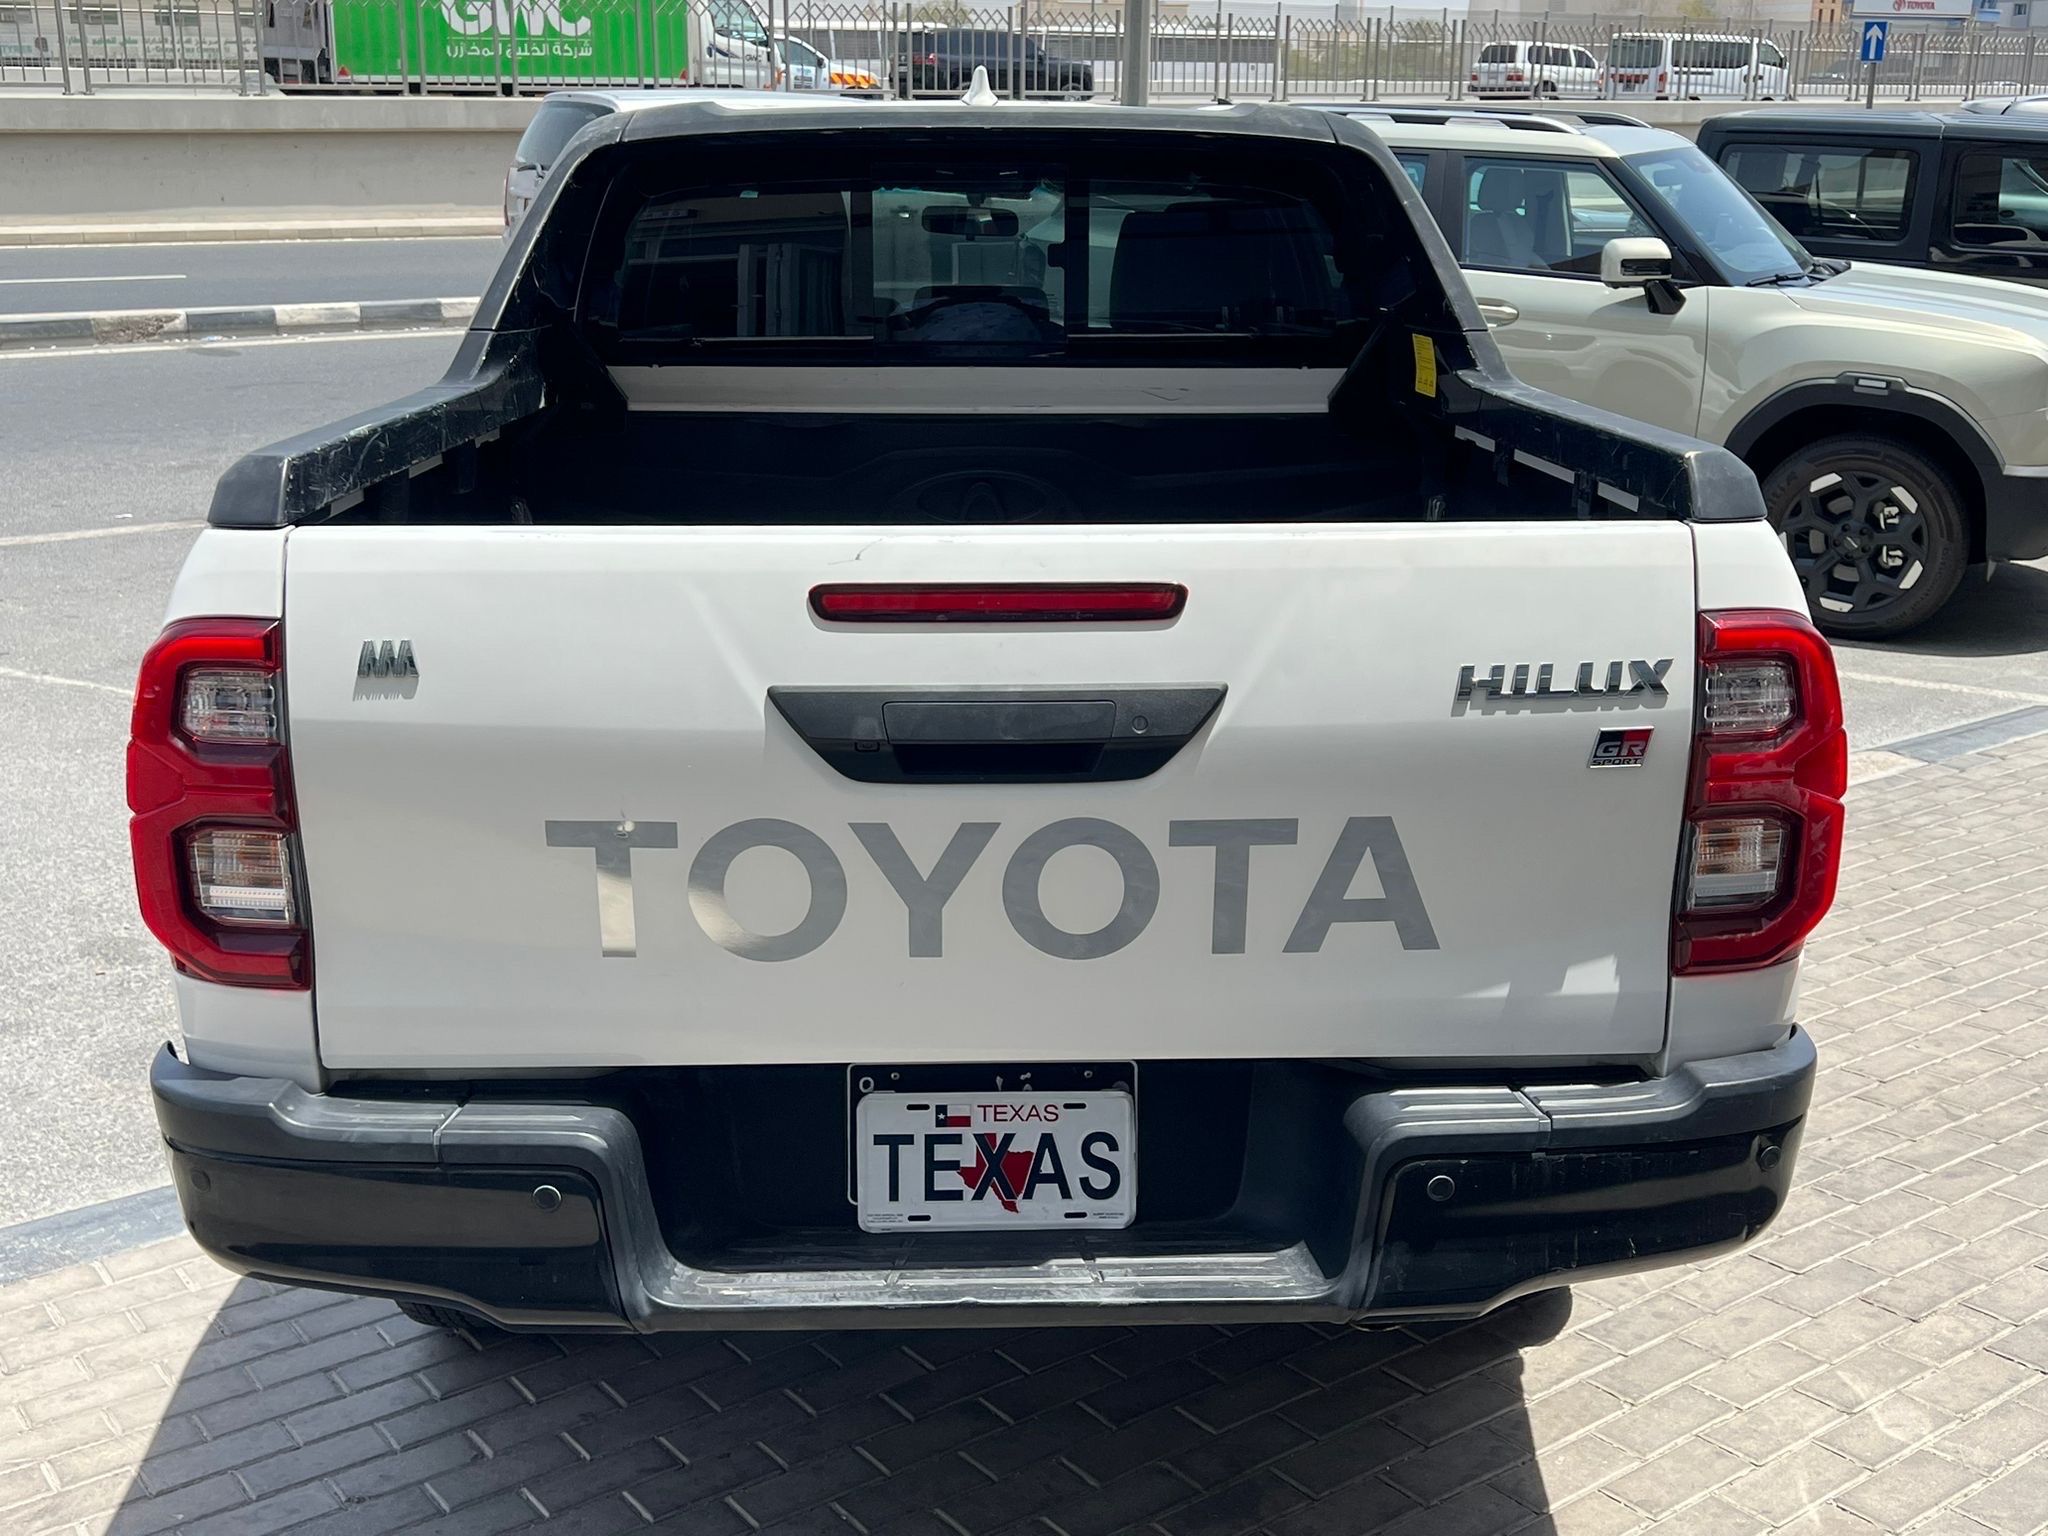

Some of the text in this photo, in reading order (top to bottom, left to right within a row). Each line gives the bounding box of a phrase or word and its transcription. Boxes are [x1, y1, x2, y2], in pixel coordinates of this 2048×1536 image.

[1907, 1, 1936, 10] TOYOTA
[1456, 658, 1674, 701] HILUX
[1596, 741, 1647, 757] GR
[1591, 758, 1642, 767] SPORT
[545, 816, 1441, 962] TOYOTA
[976, 1104, 1060, 1123] TEXAS
[873, 1131, 1121, 1202] TEXAS
